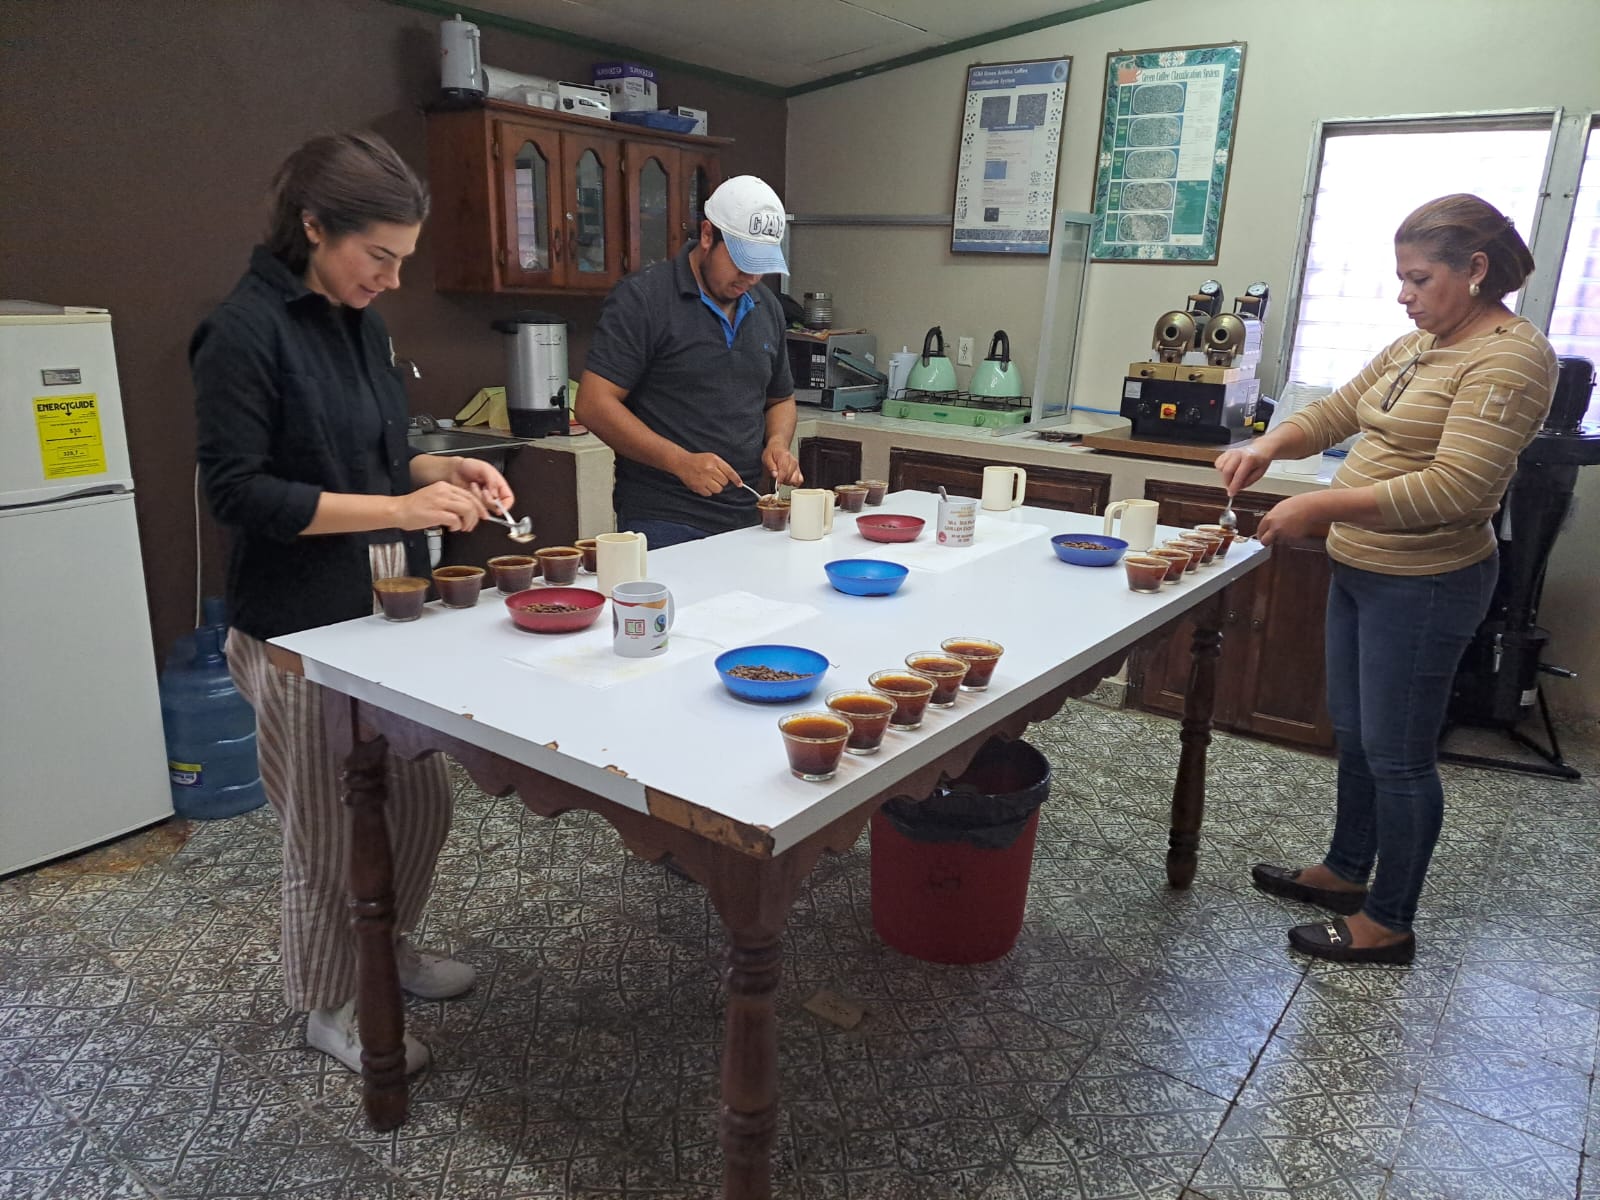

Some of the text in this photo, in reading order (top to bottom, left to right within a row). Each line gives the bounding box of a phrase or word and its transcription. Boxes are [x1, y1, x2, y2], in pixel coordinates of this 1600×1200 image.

[1142, 69, 1220, 82] Green Coffee Classification System
[37, 401, 95, 413] ENERGYGUIDE
